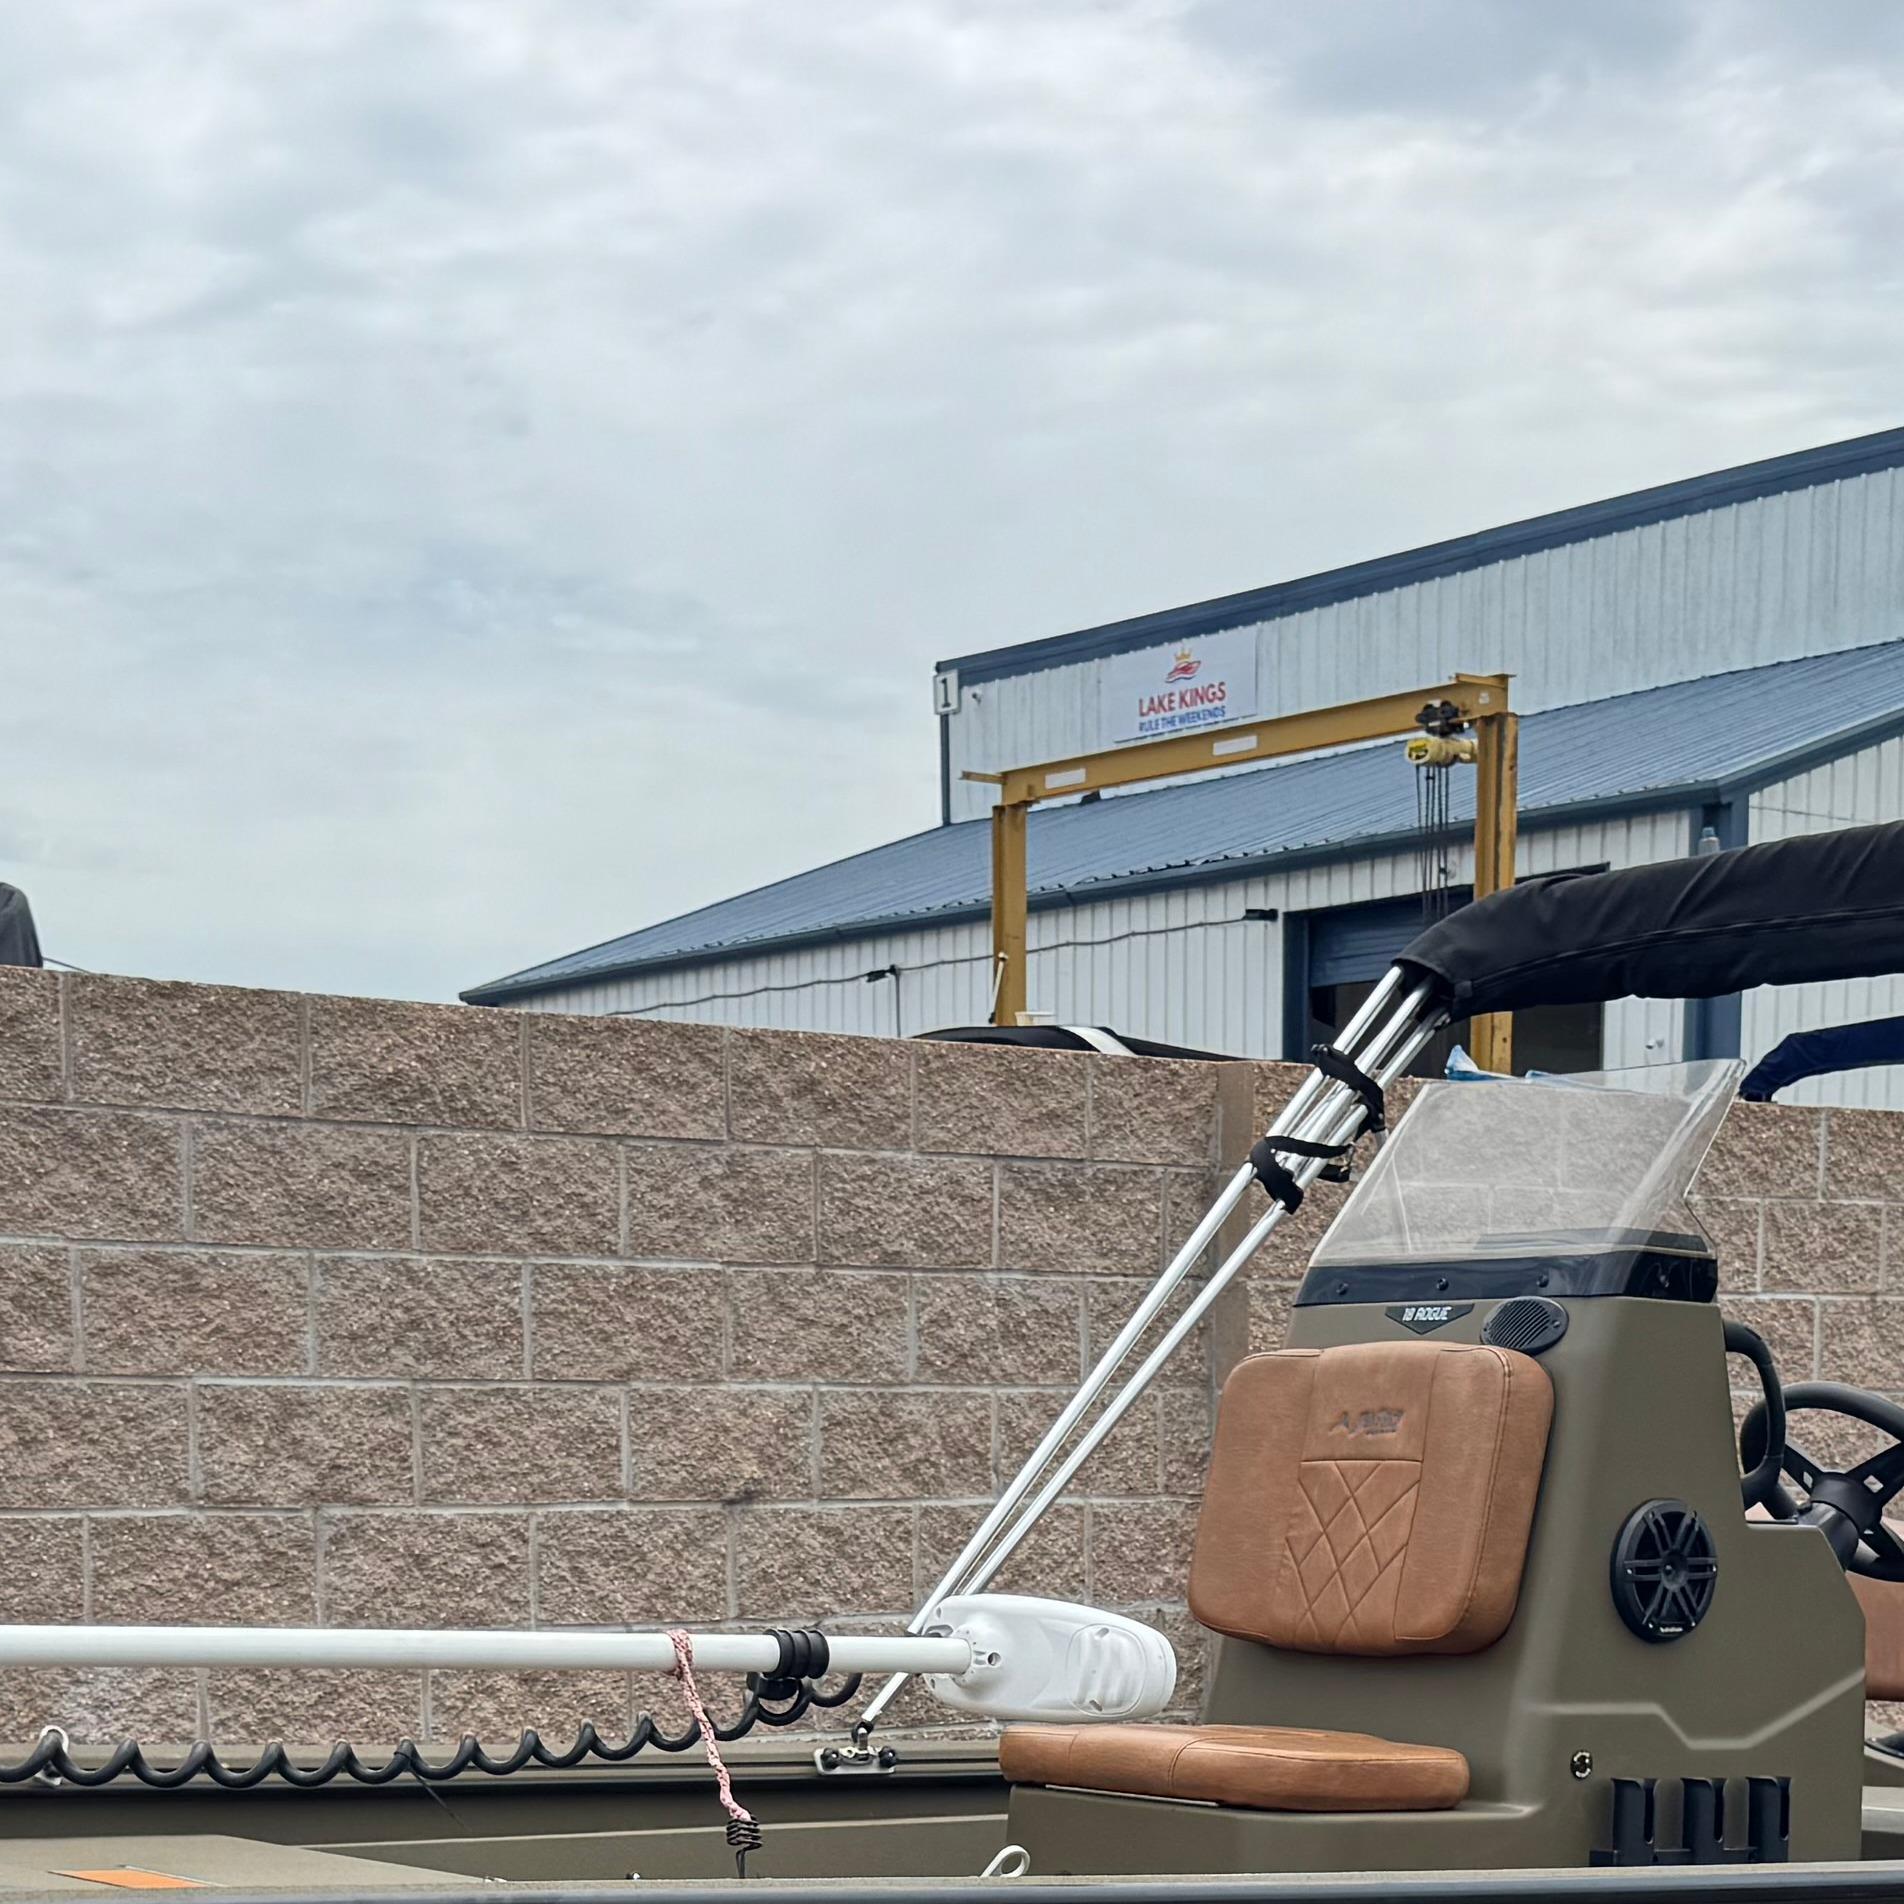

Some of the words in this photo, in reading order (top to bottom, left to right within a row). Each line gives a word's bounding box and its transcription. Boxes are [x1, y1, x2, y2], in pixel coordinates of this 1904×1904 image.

[941, 678, 952, 709] 1
[1139, 693, 1176, 717] LAKE
[1179, 681, 1227, 709] KINGS
[1139, 719, 1160, 732] RULE
[1161, 716, 1177, 728] THE
[1178, 705, 1227, 724] WEEKENDS
